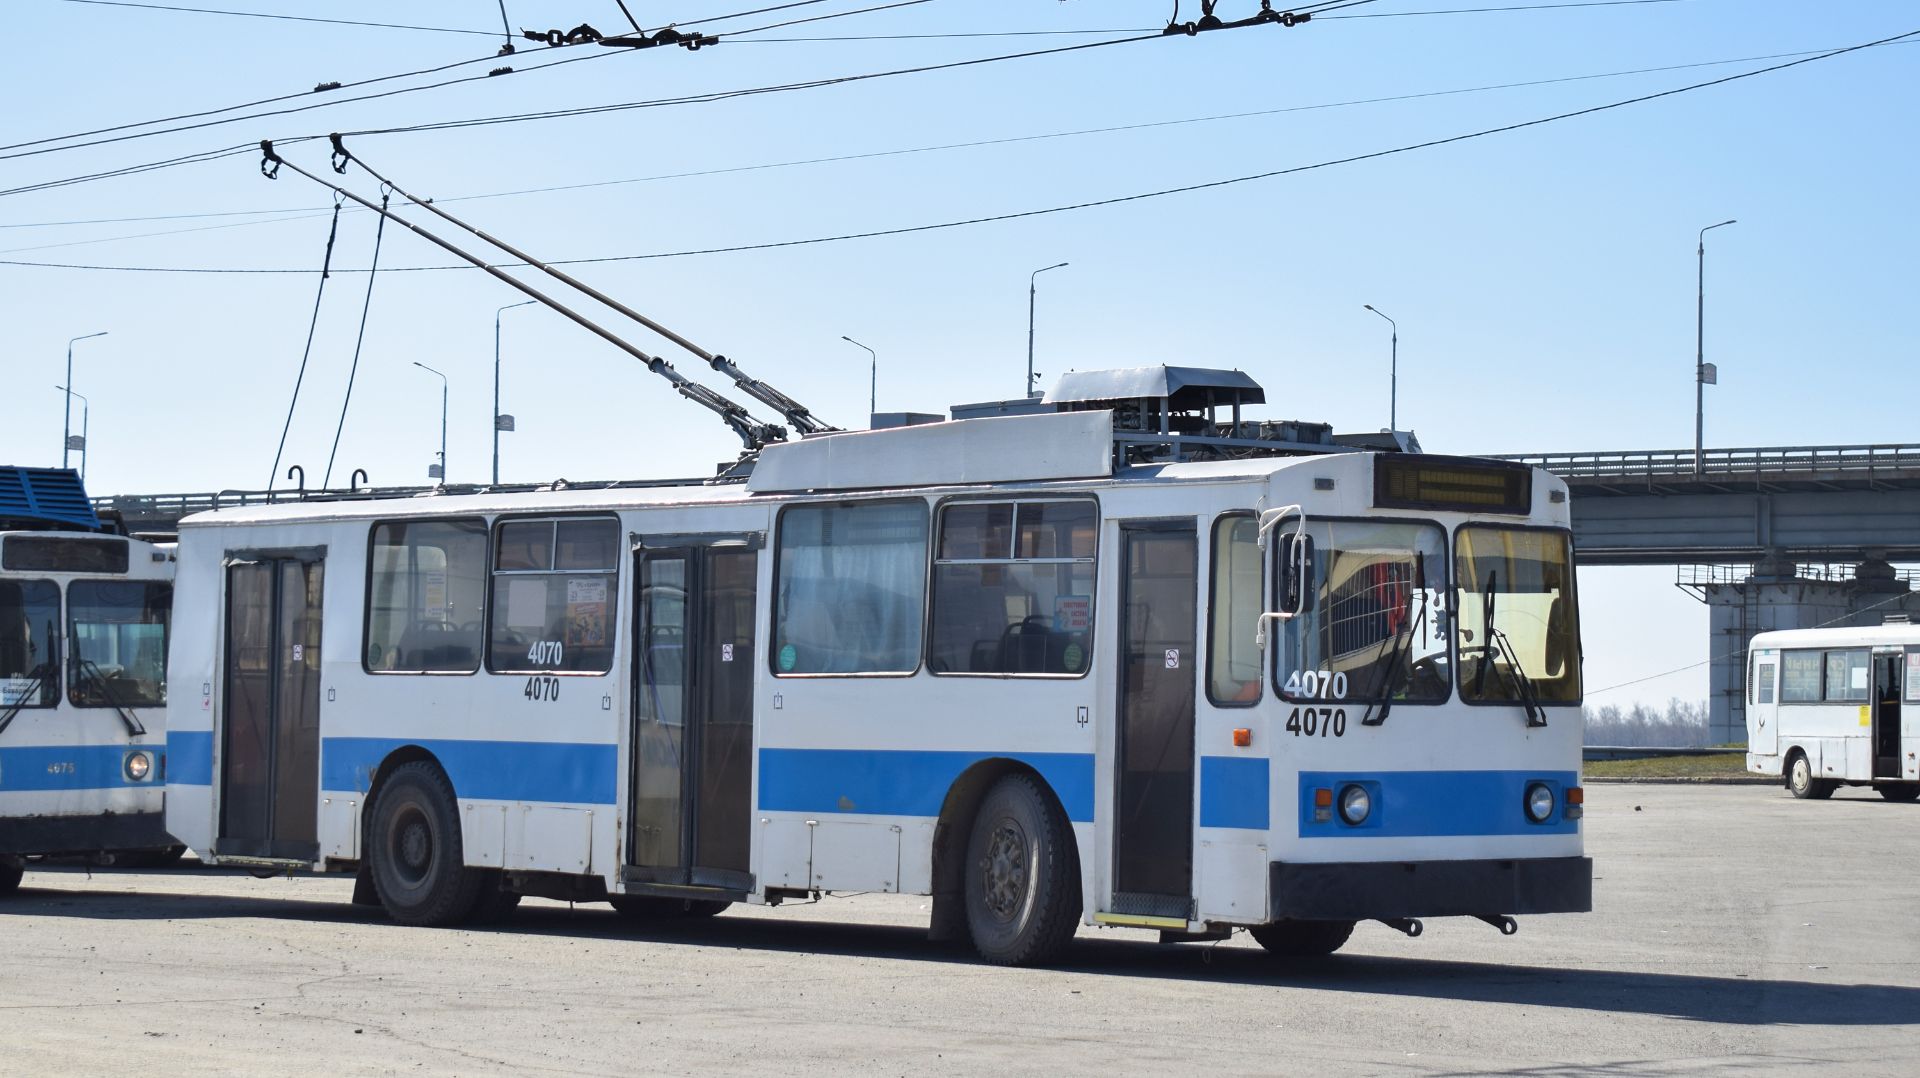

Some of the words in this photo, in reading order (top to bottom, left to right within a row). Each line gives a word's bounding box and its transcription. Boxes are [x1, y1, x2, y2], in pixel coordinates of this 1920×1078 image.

[527, 640, 563, 666] 4070
[524, 676, 560, 702] 4070
[1283, 669, 1348, 700] 4070
[1285, 707, 1347, 738] 4070
[47, 762, 75, 775] 4075
